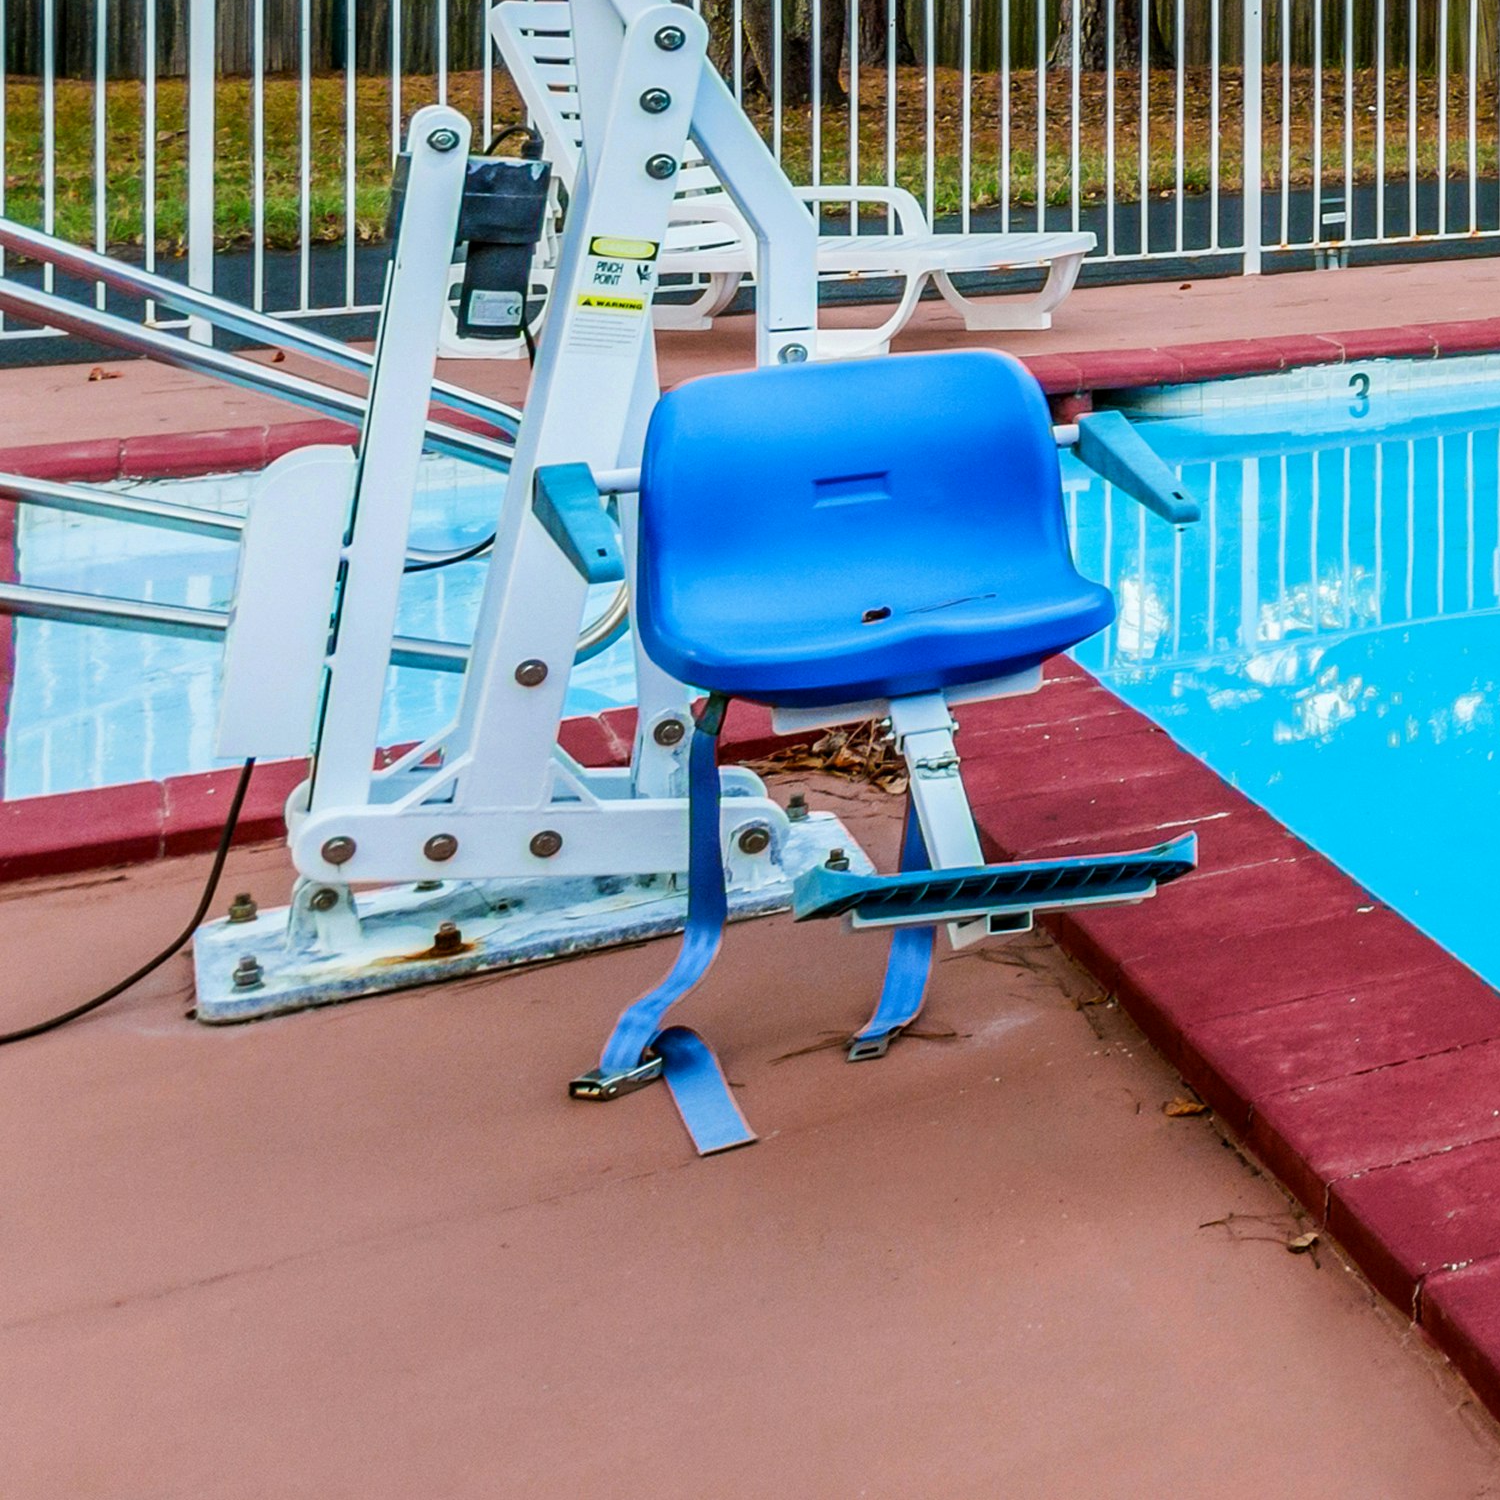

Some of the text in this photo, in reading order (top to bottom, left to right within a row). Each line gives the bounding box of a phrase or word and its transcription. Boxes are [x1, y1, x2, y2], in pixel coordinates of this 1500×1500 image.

[596, 261, 624, 273] PINCH
[593, 273, 621, 285] POINT
[596, 300, 643, 310] WARNING
